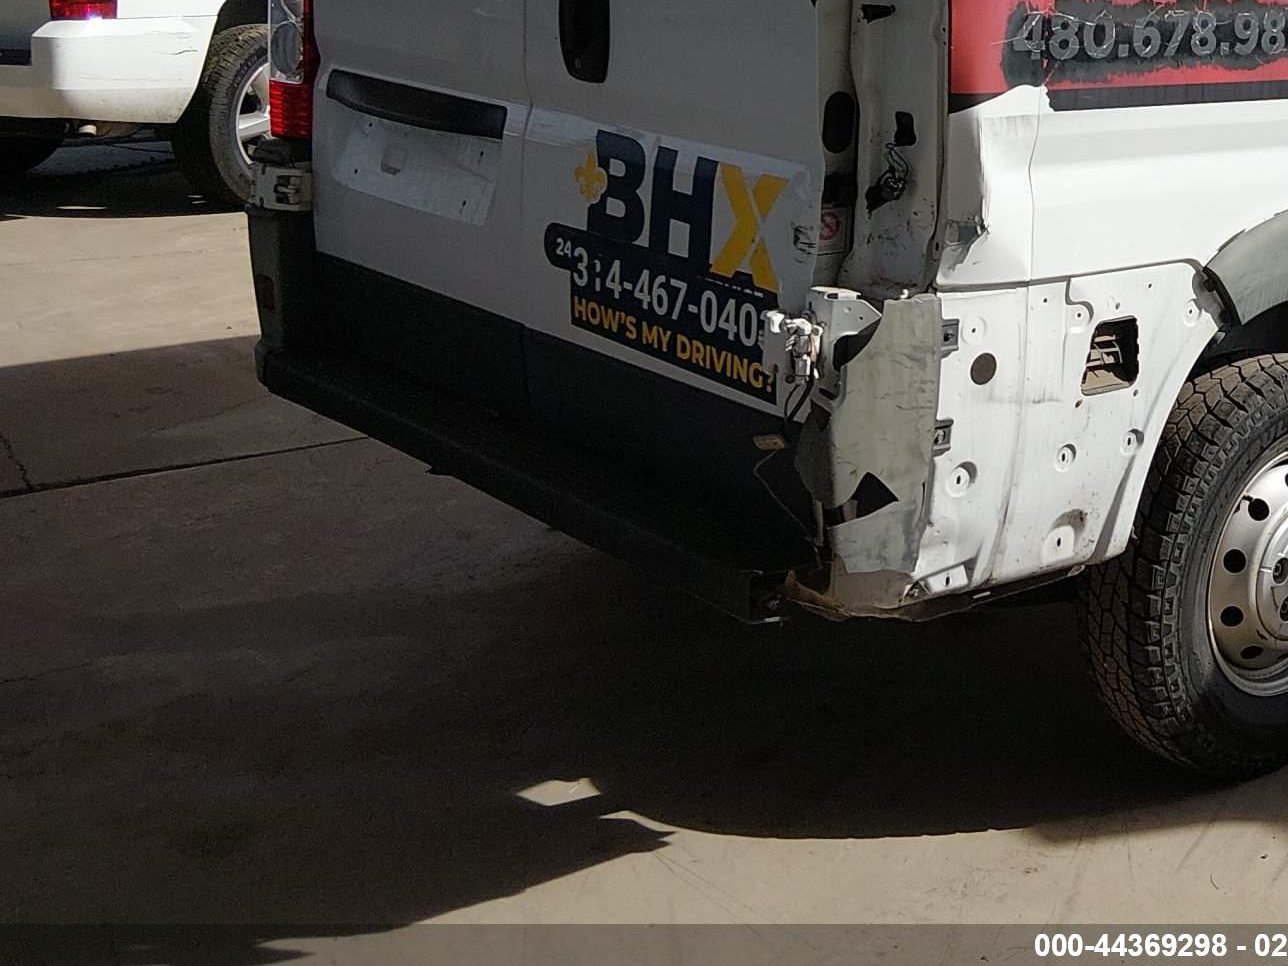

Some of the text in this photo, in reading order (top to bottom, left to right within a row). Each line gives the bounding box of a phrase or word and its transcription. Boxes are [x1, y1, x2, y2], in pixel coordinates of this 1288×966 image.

[587, 129, 789, 295] BHX
[573, 295, 776, 392] HOW'S MY DRIVING?
